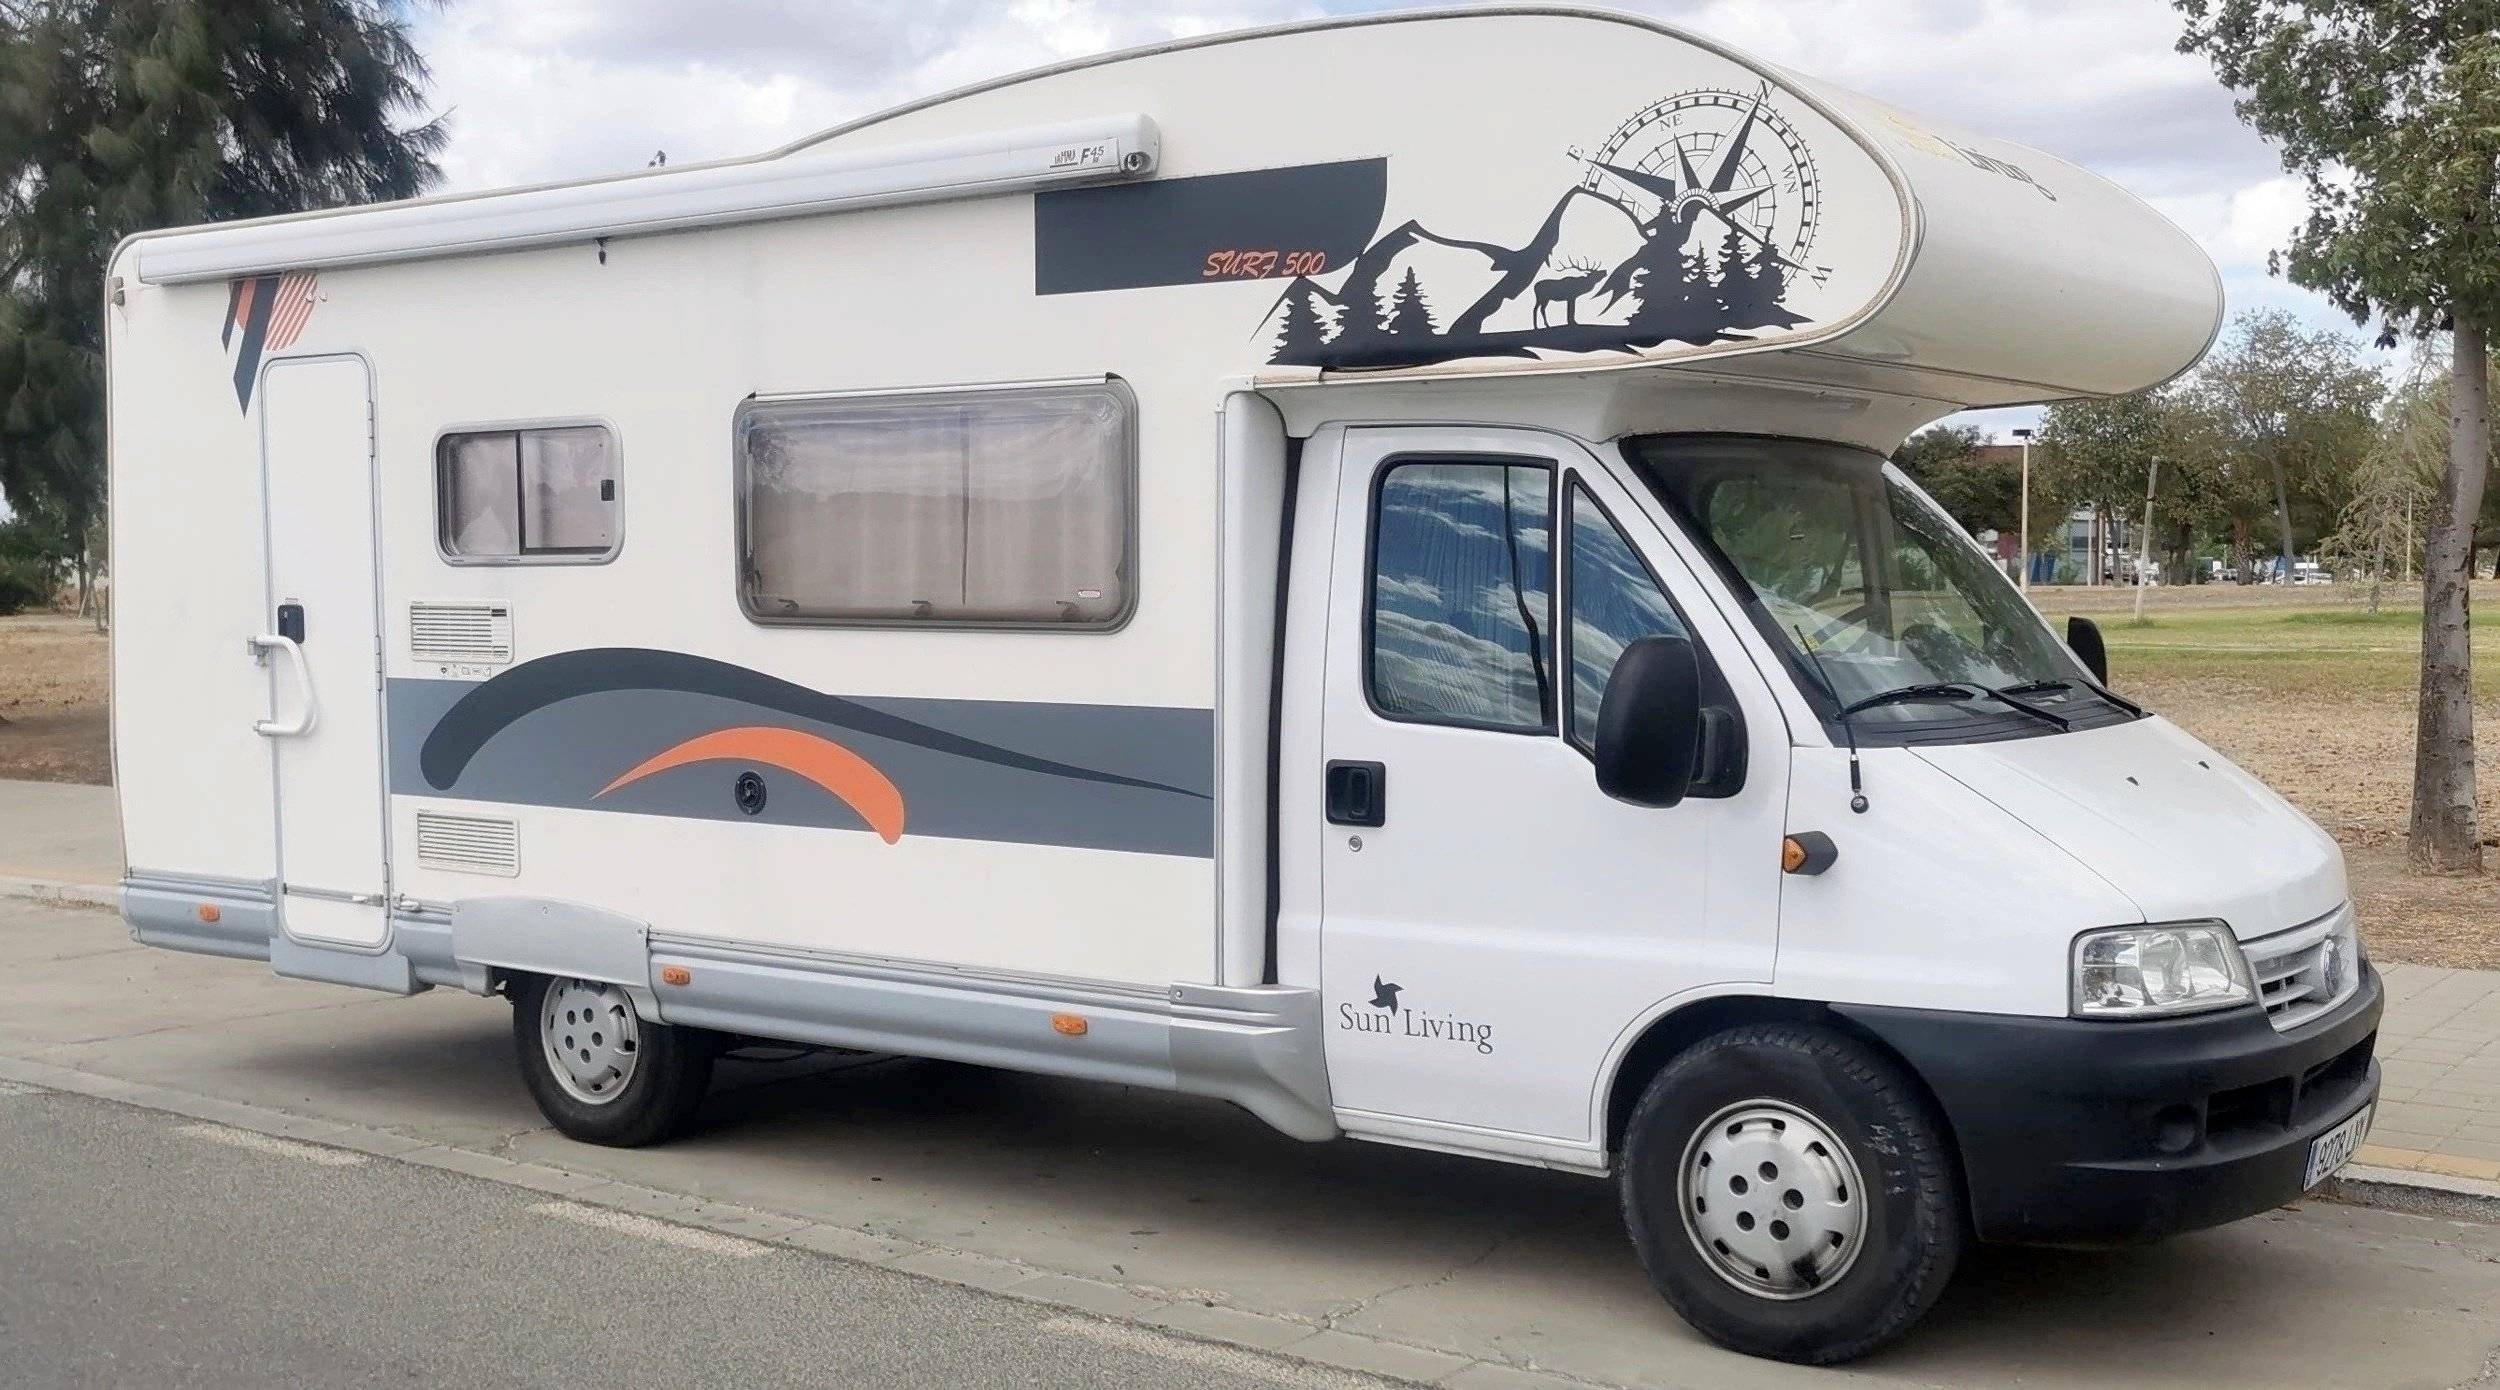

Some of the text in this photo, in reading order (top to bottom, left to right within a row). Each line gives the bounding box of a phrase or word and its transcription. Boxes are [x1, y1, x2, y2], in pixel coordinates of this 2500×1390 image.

[1659, 113, 1684, 132] NE
[1565, 145, 1585, 163] E
[1202, 250, 1327, 280] SURF 500
[1339, 1002, 1494, 1055] Sun Living
